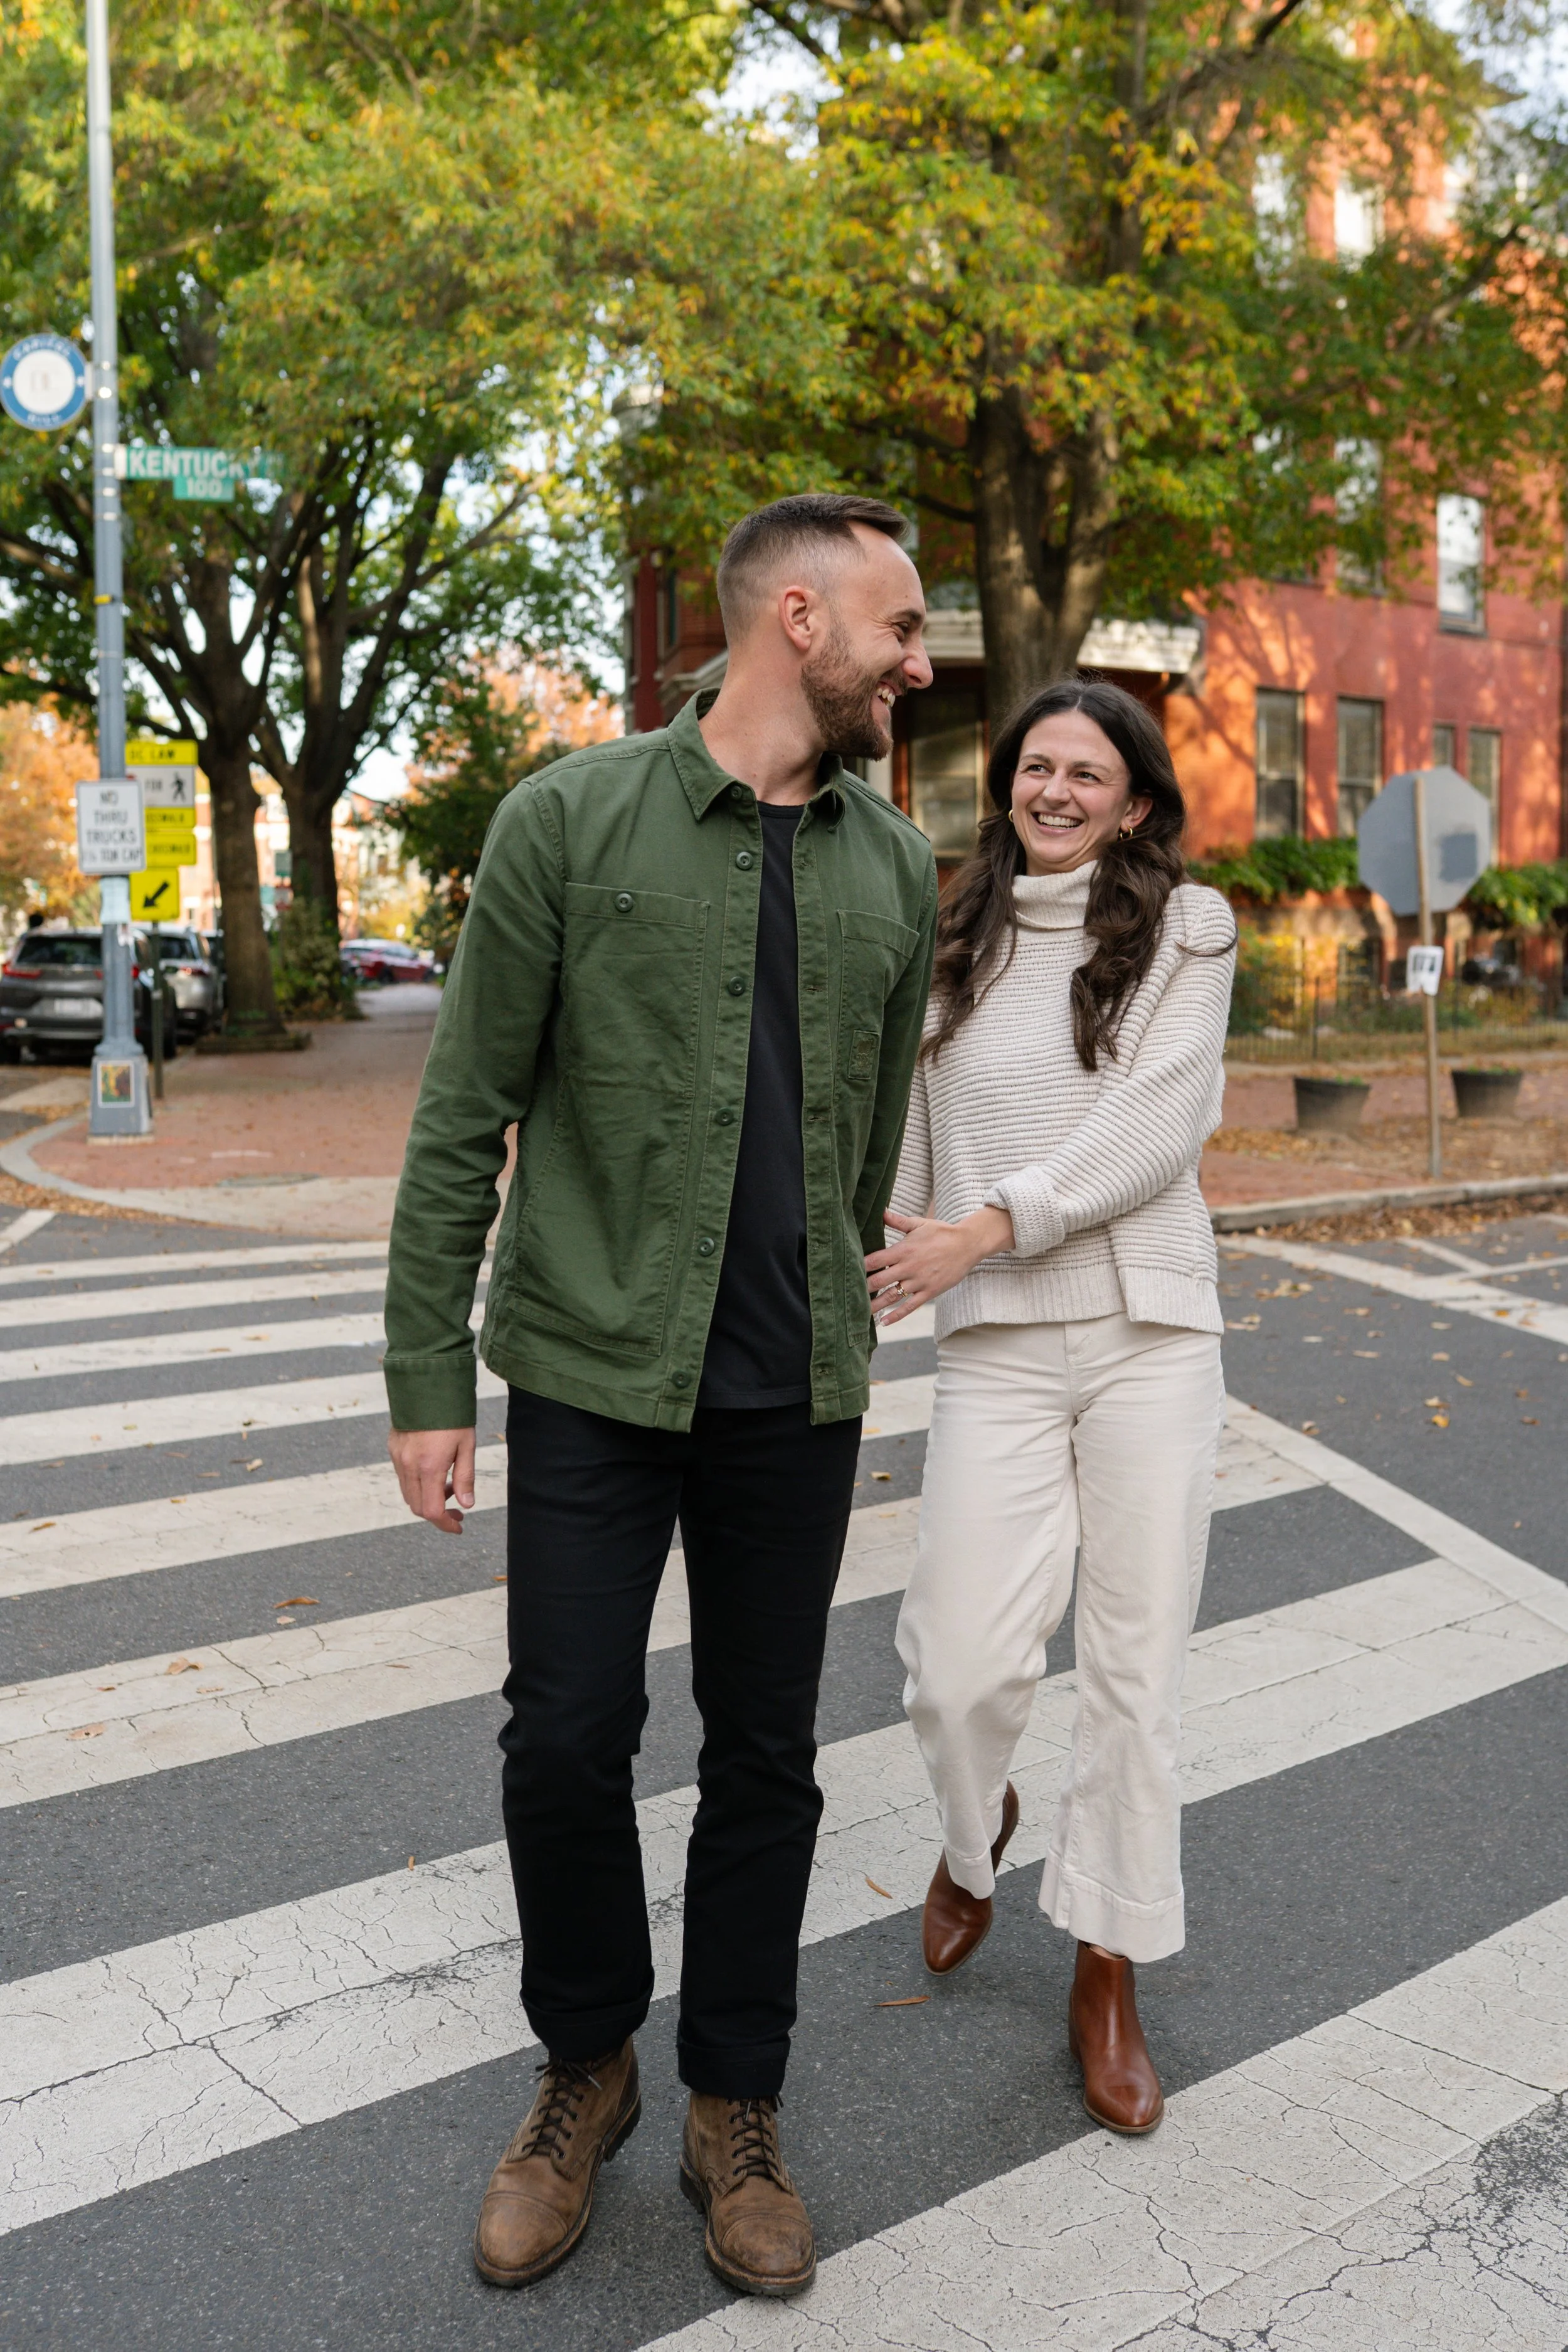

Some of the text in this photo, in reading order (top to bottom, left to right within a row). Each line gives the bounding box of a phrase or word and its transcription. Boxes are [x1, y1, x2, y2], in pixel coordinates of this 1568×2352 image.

[100, 791, 118, 805] NO
[94, 810, 127, 825] THRU
[87, 829, 137, 844] TRUCKS
